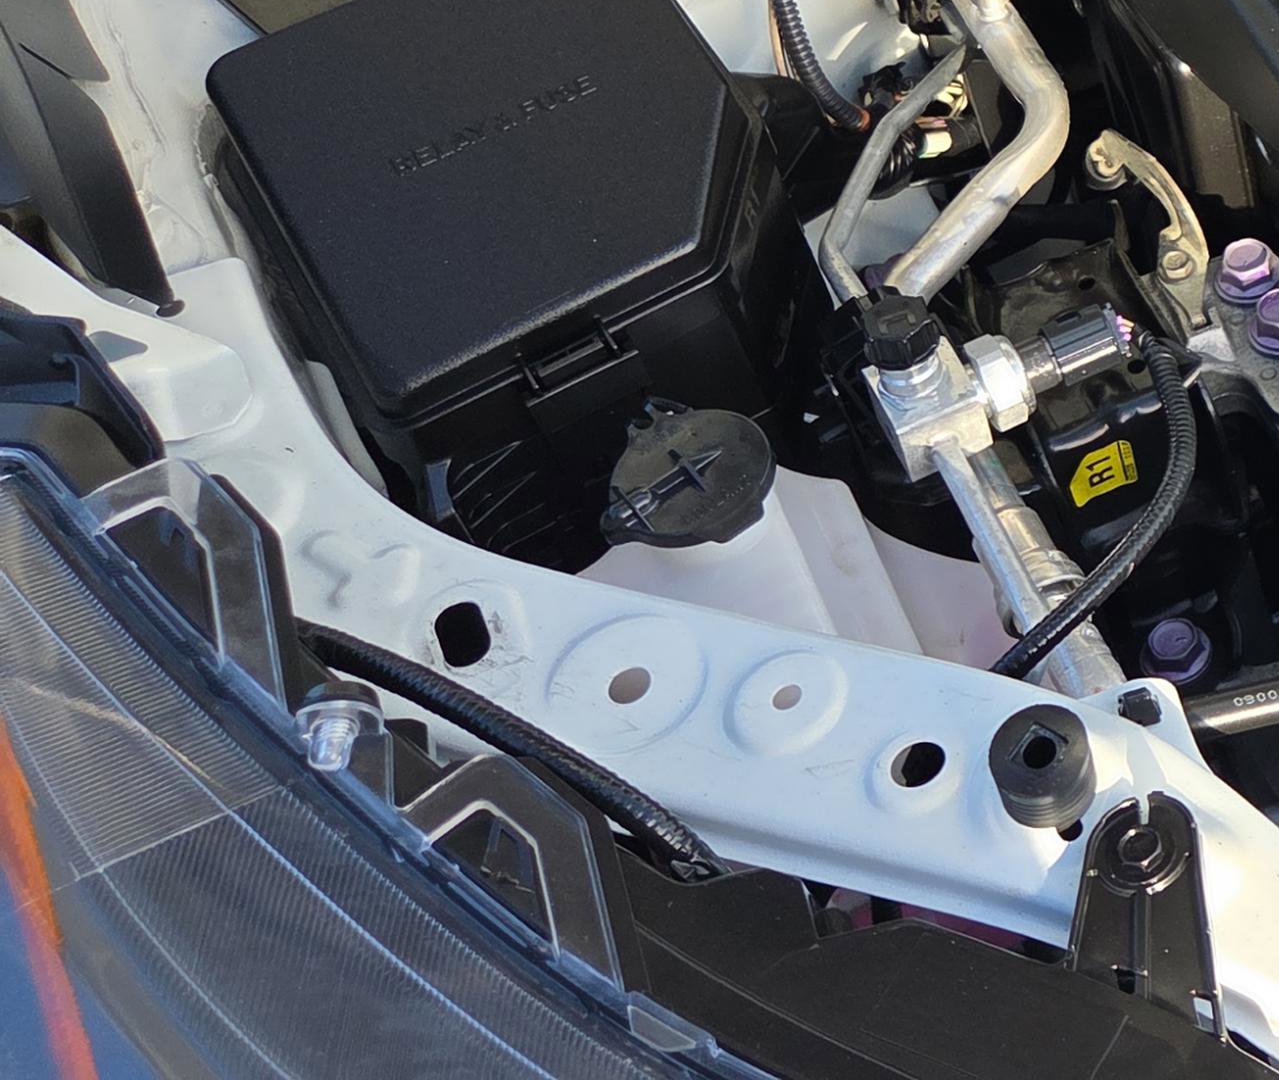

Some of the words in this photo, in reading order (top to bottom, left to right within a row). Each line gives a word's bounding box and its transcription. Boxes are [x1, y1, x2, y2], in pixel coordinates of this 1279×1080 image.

[388, 125, 489, 177] RELAY
[520, 74, 599, 121] FUSE
[1085, 456, 1115, 488] R1
